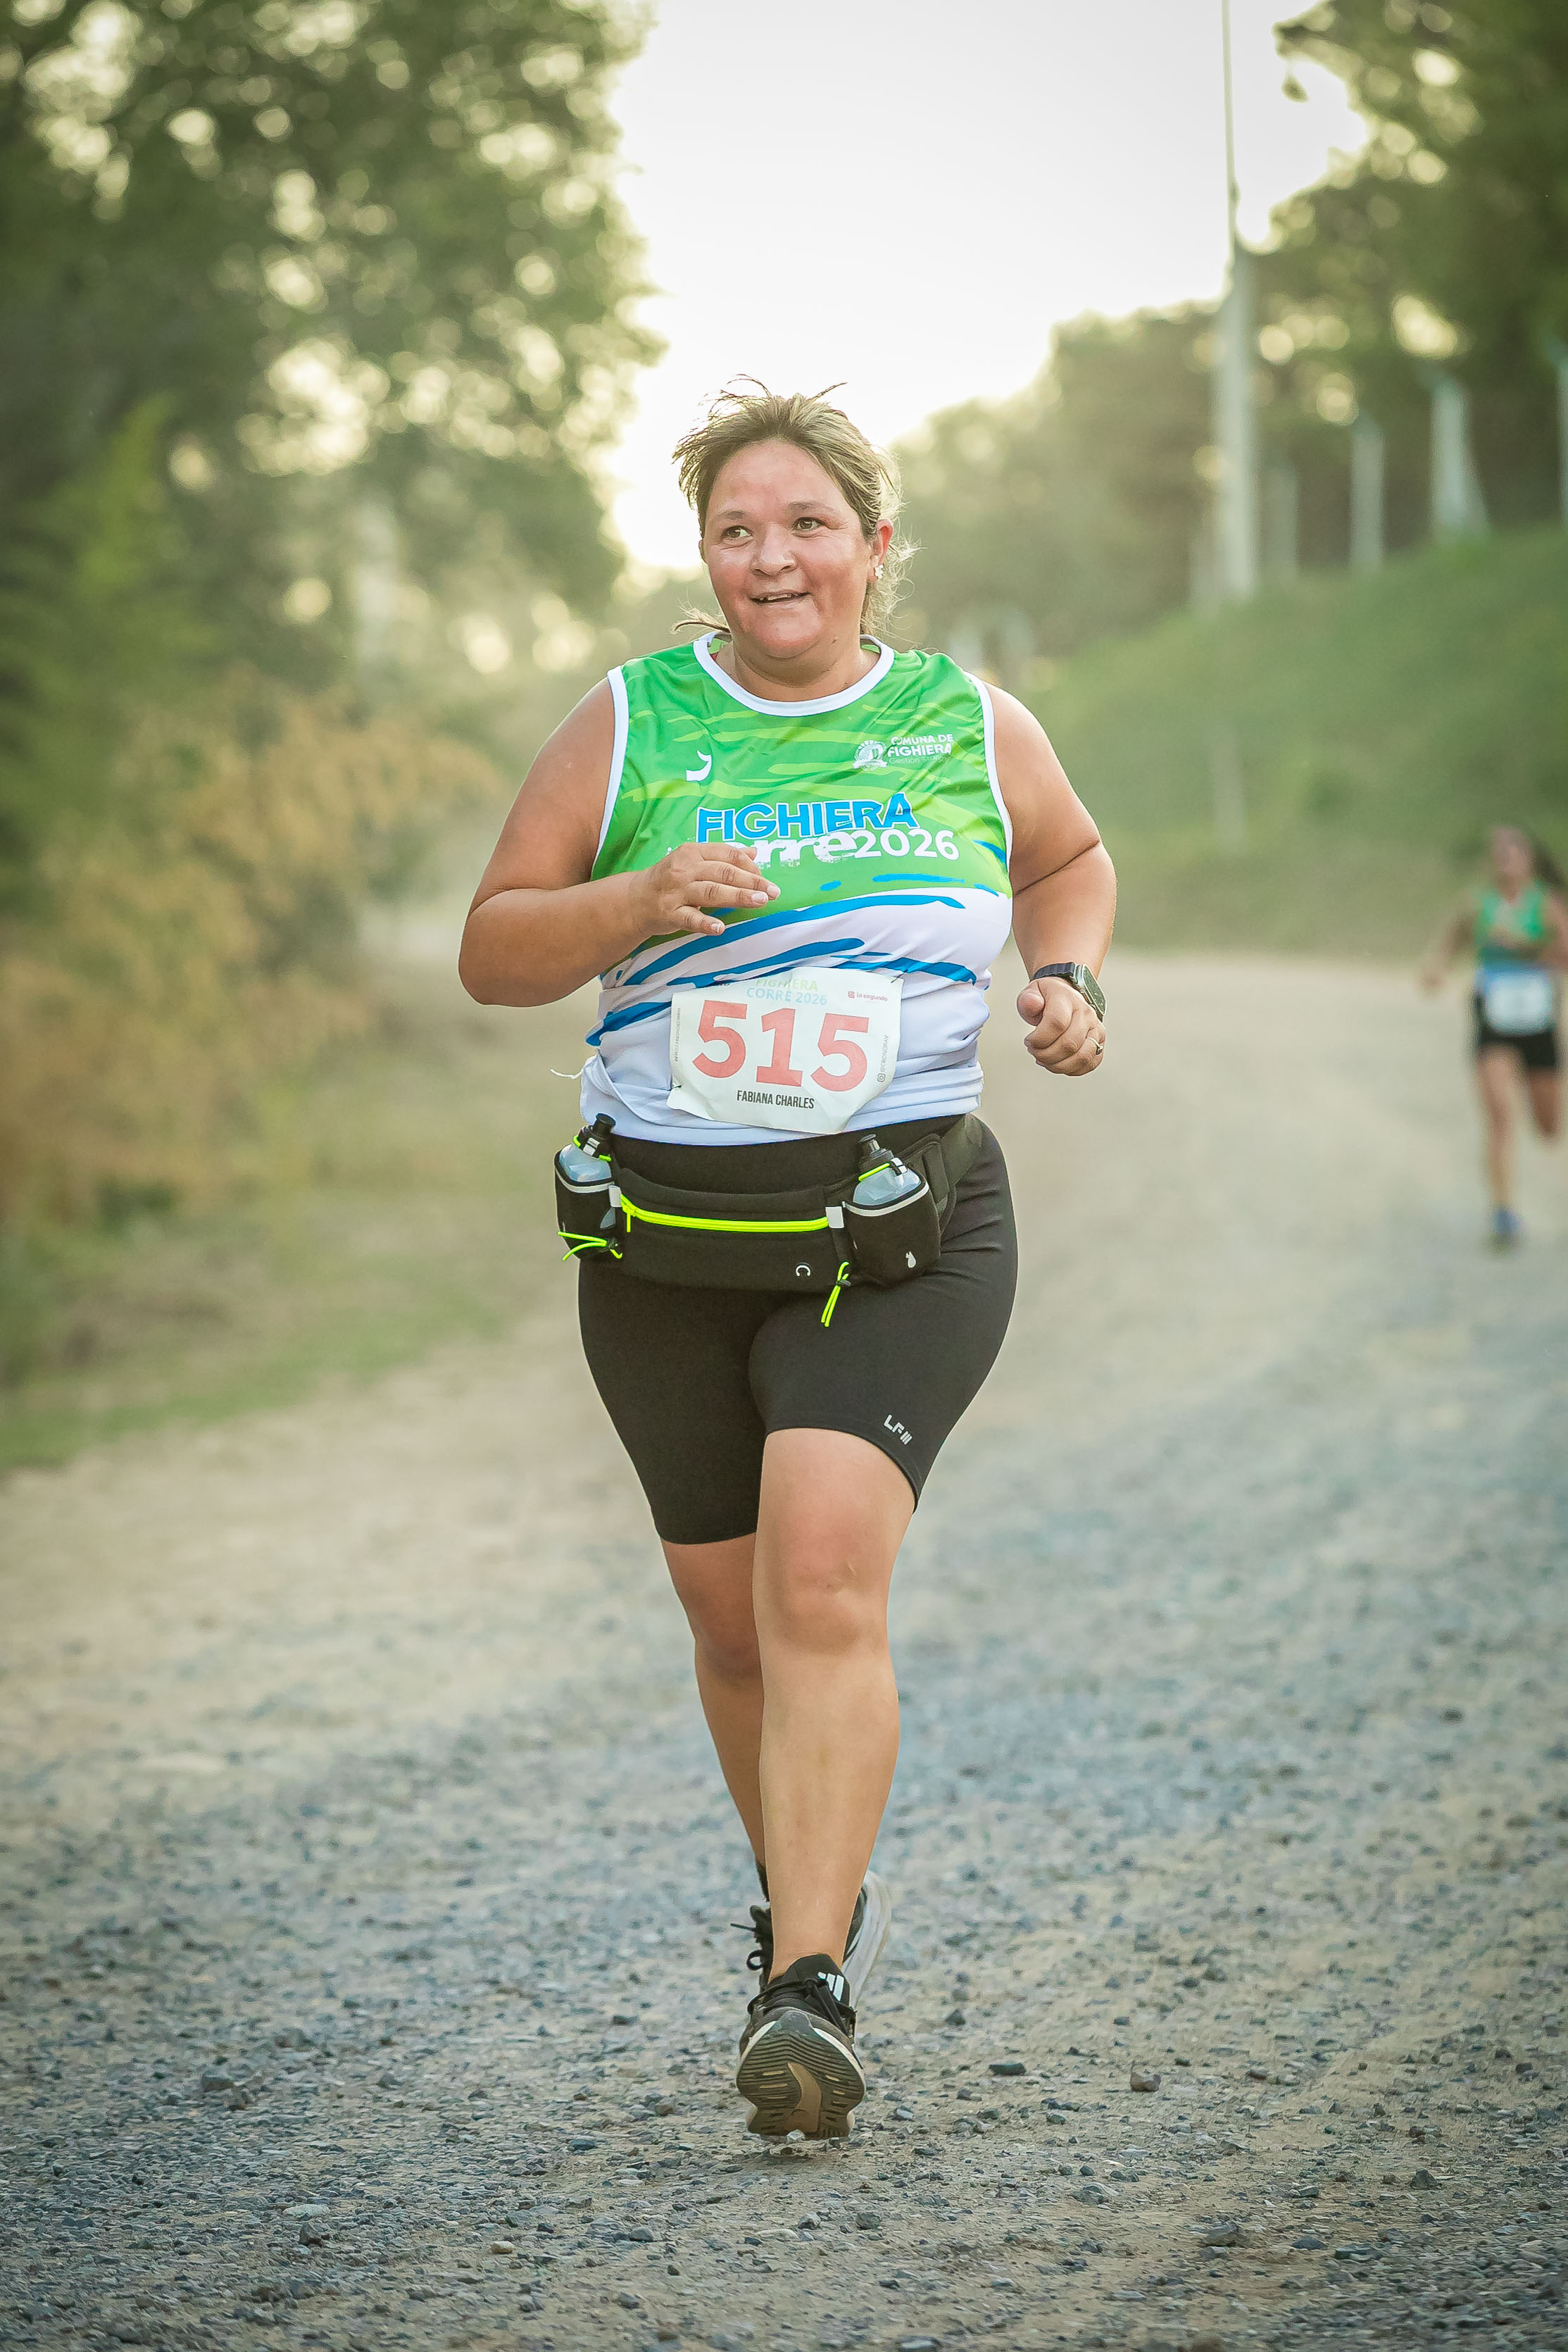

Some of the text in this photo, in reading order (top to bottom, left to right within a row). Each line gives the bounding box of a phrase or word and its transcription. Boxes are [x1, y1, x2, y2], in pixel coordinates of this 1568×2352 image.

[938, 734, 954, 743] DE
[888, 743, 952, 758] FIGHIERA
[696, 792, 919, 844] FIGHIERA
[853, 829, 960, 861] 2026
[747, 987, 828, 1006] CORRE 2026
[692, 1000, 870, 1091] 515
[736, 1090, 815, 1109] FABIANA CHARLES
